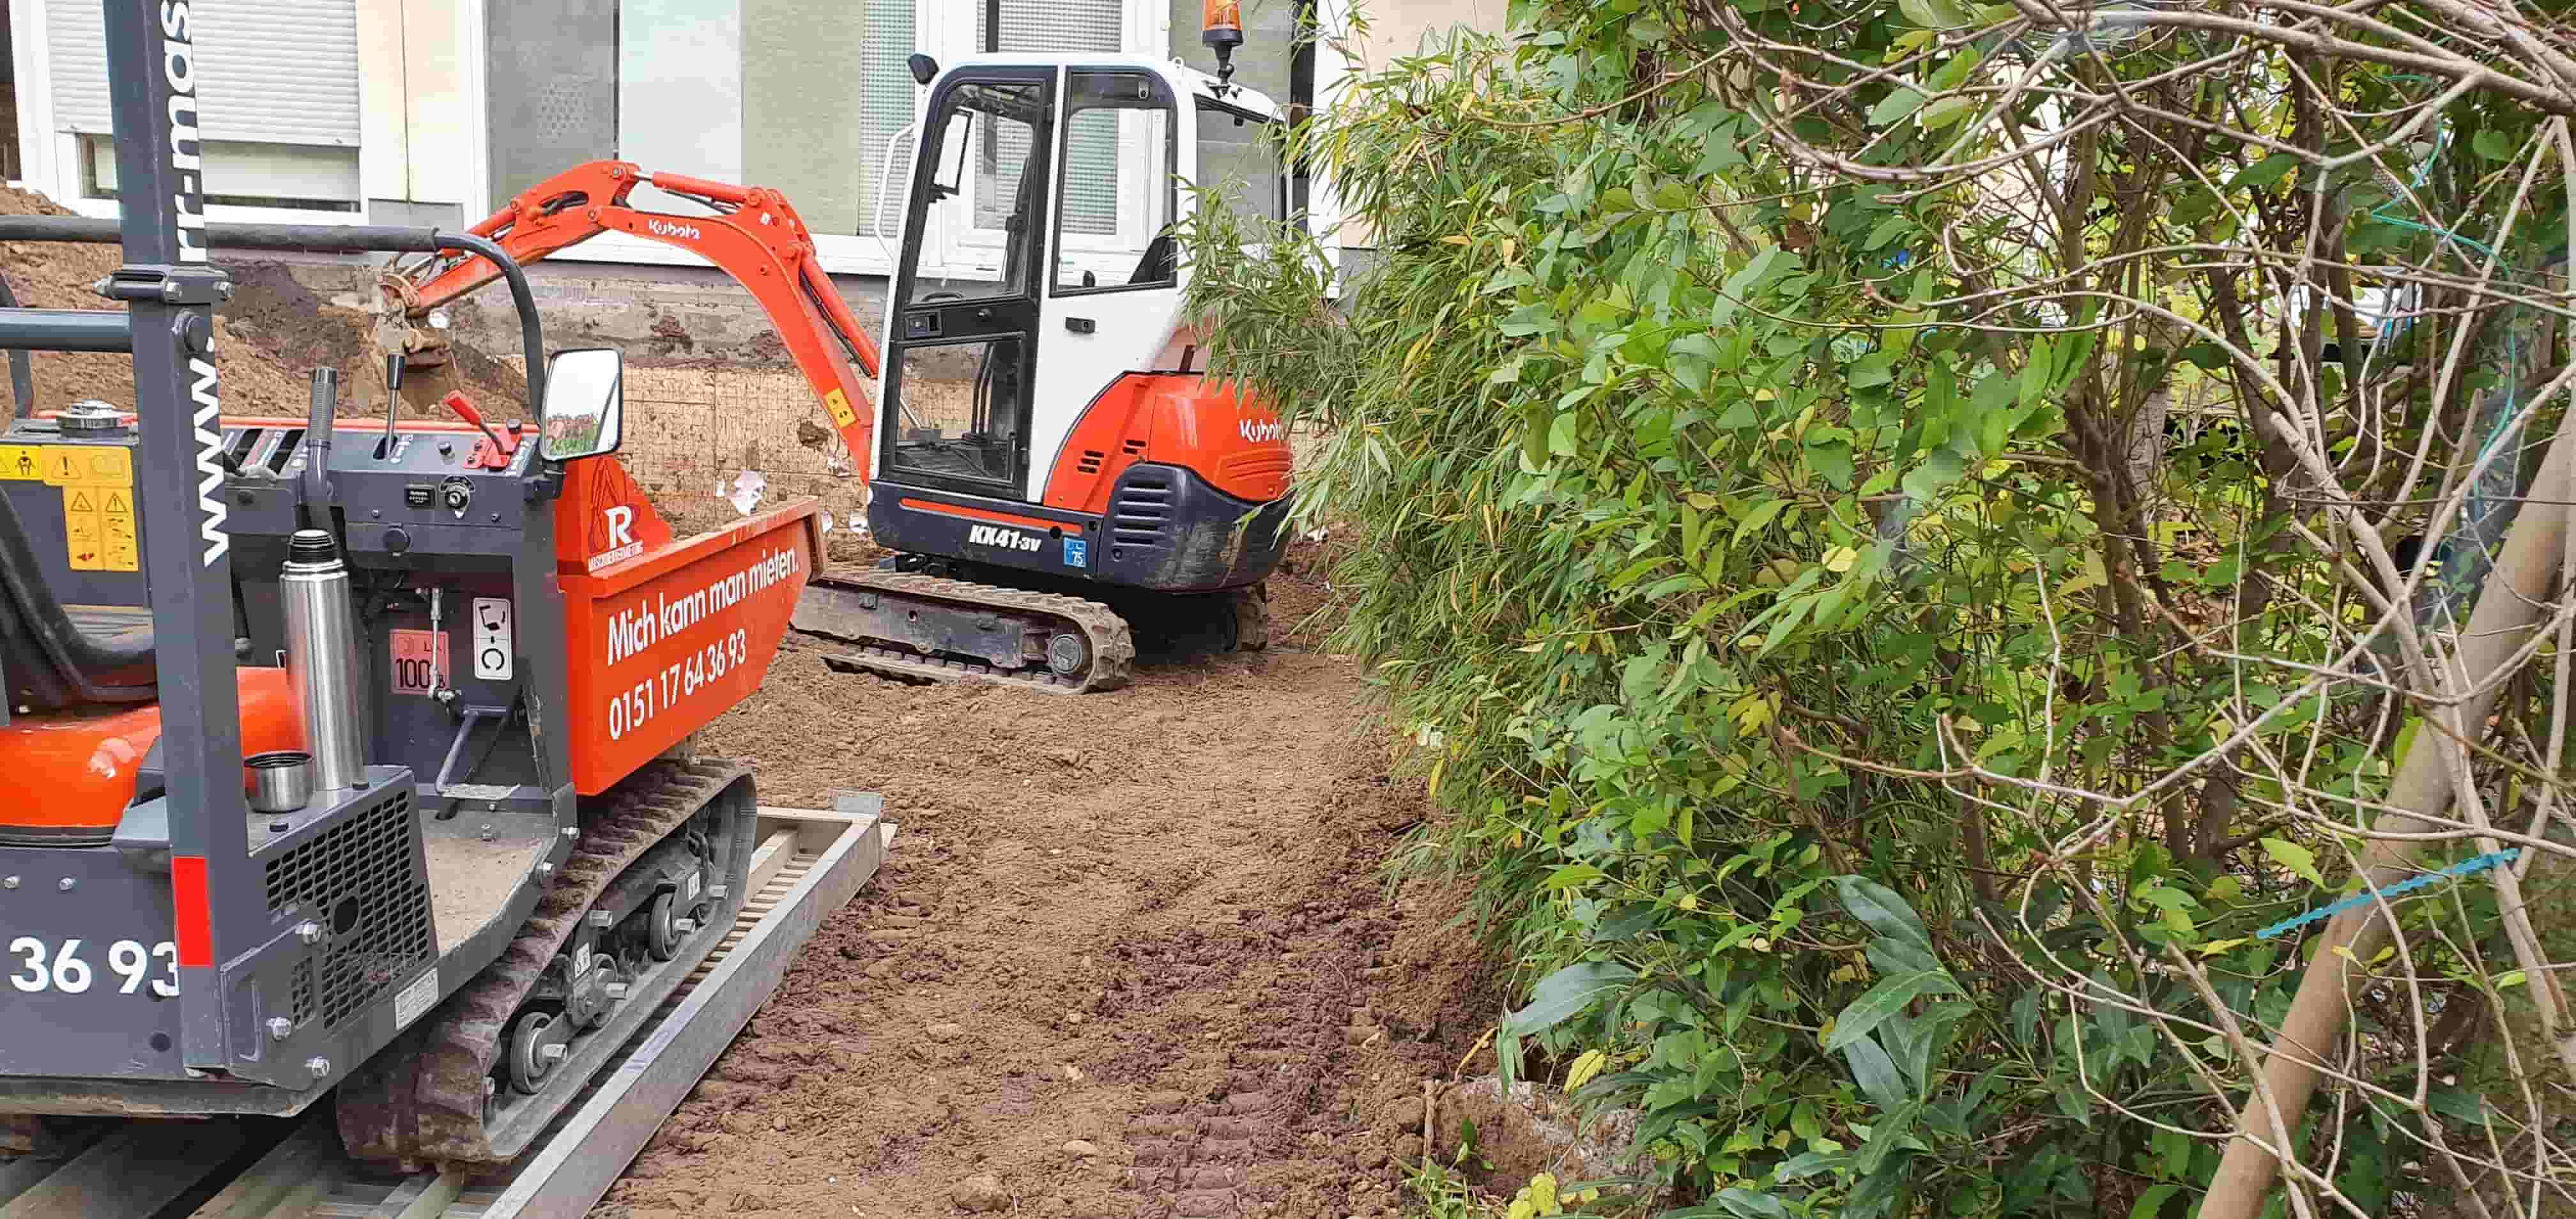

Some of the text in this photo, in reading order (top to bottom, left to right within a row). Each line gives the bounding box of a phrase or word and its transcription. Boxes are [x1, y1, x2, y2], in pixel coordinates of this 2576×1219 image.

[648, 218, 700, 240] Kubota
[603, 505, 632, 549] R
[608, 547, 799, 666] Mich kann man mieten.
[395, 657, 430, 689] 100
[609, 627, 746, 740] 0151 17 64 36 93
[10, 936, 180, 997] 36 93
